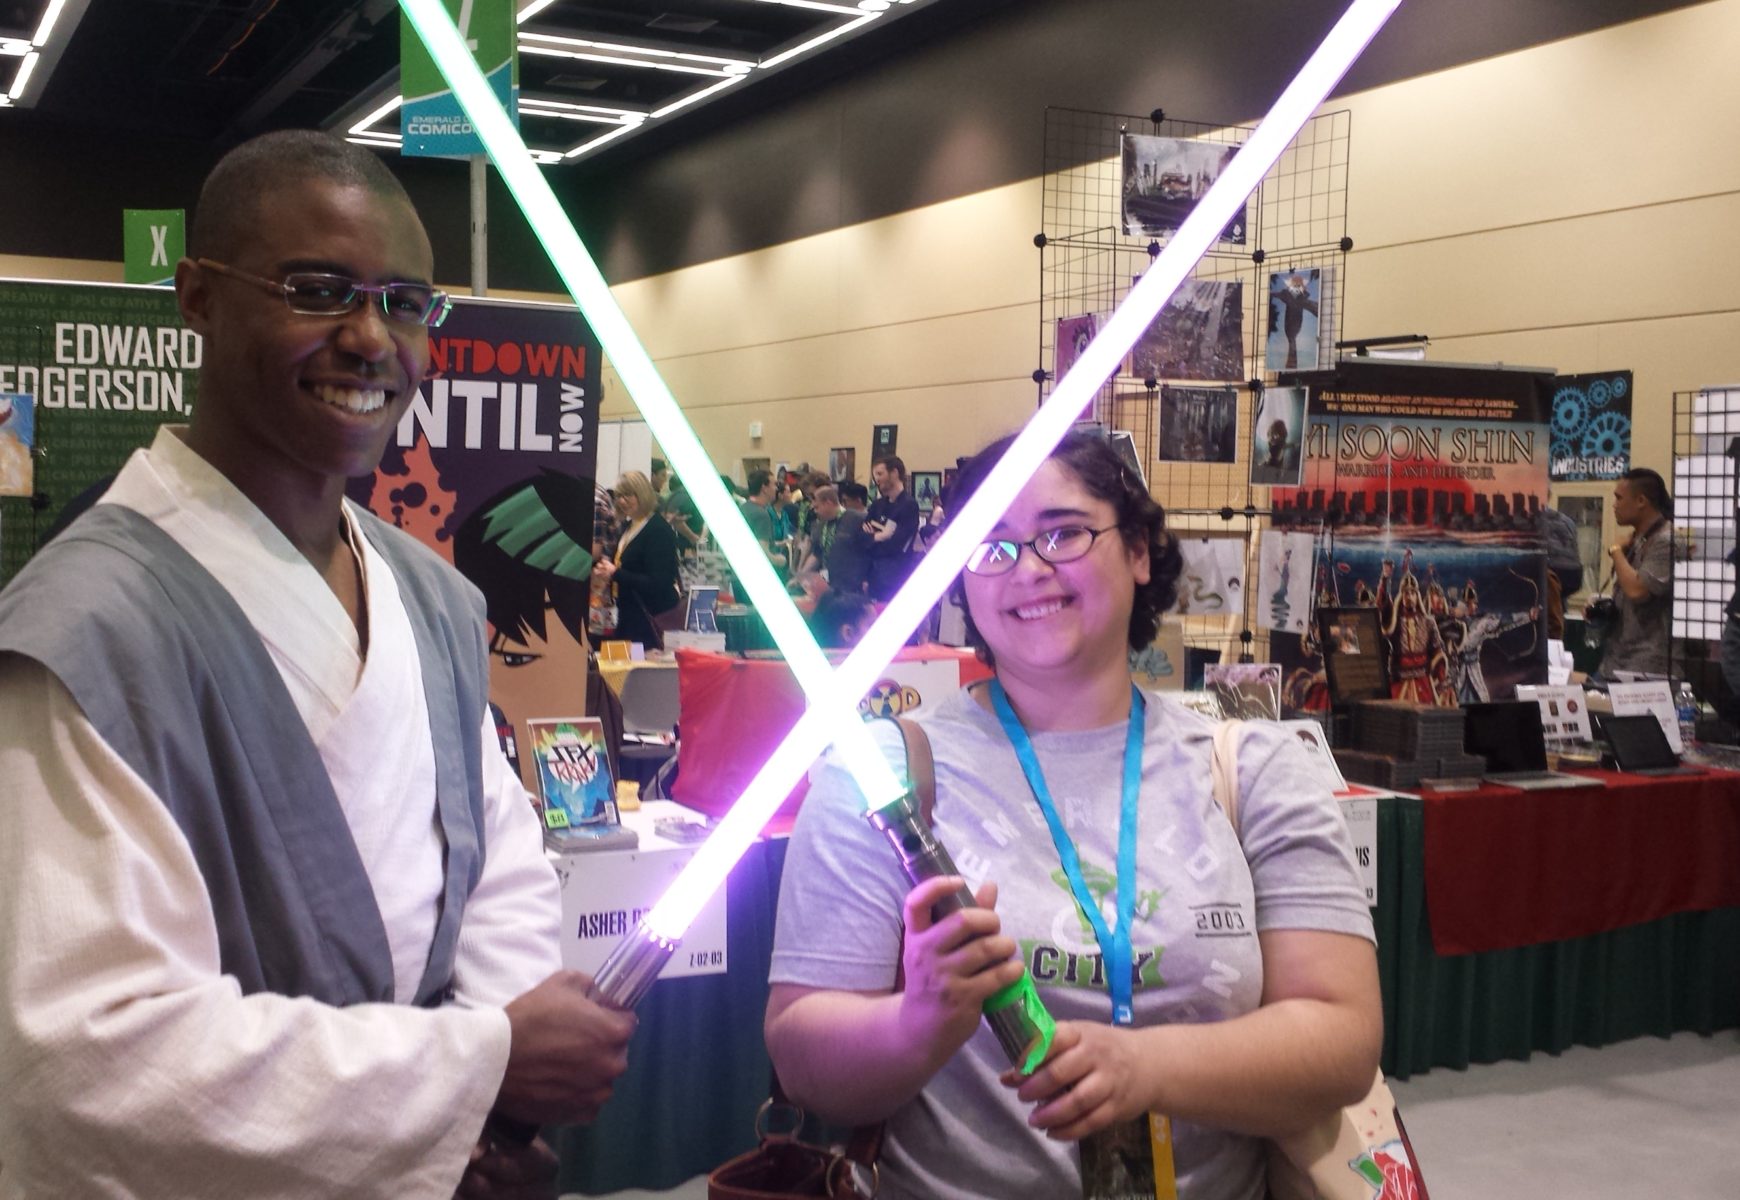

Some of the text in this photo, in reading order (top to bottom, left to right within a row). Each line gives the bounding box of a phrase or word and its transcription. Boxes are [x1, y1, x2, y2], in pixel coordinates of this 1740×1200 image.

[412, 116, 461, 124] EMERALD
[150, 225, 168, 267] X
[55, 322, 203, 370] EDWARD
[426, 337, 586, 379] NTDOWN
[397, 379, 553, 452] NTIL
[558, 382, 585, 453] NOW
[1341, 424, 1442, 462] SOON
[1451, 428, 1534, 465] SHIN
[578, 911, 627, 940] ASHER
